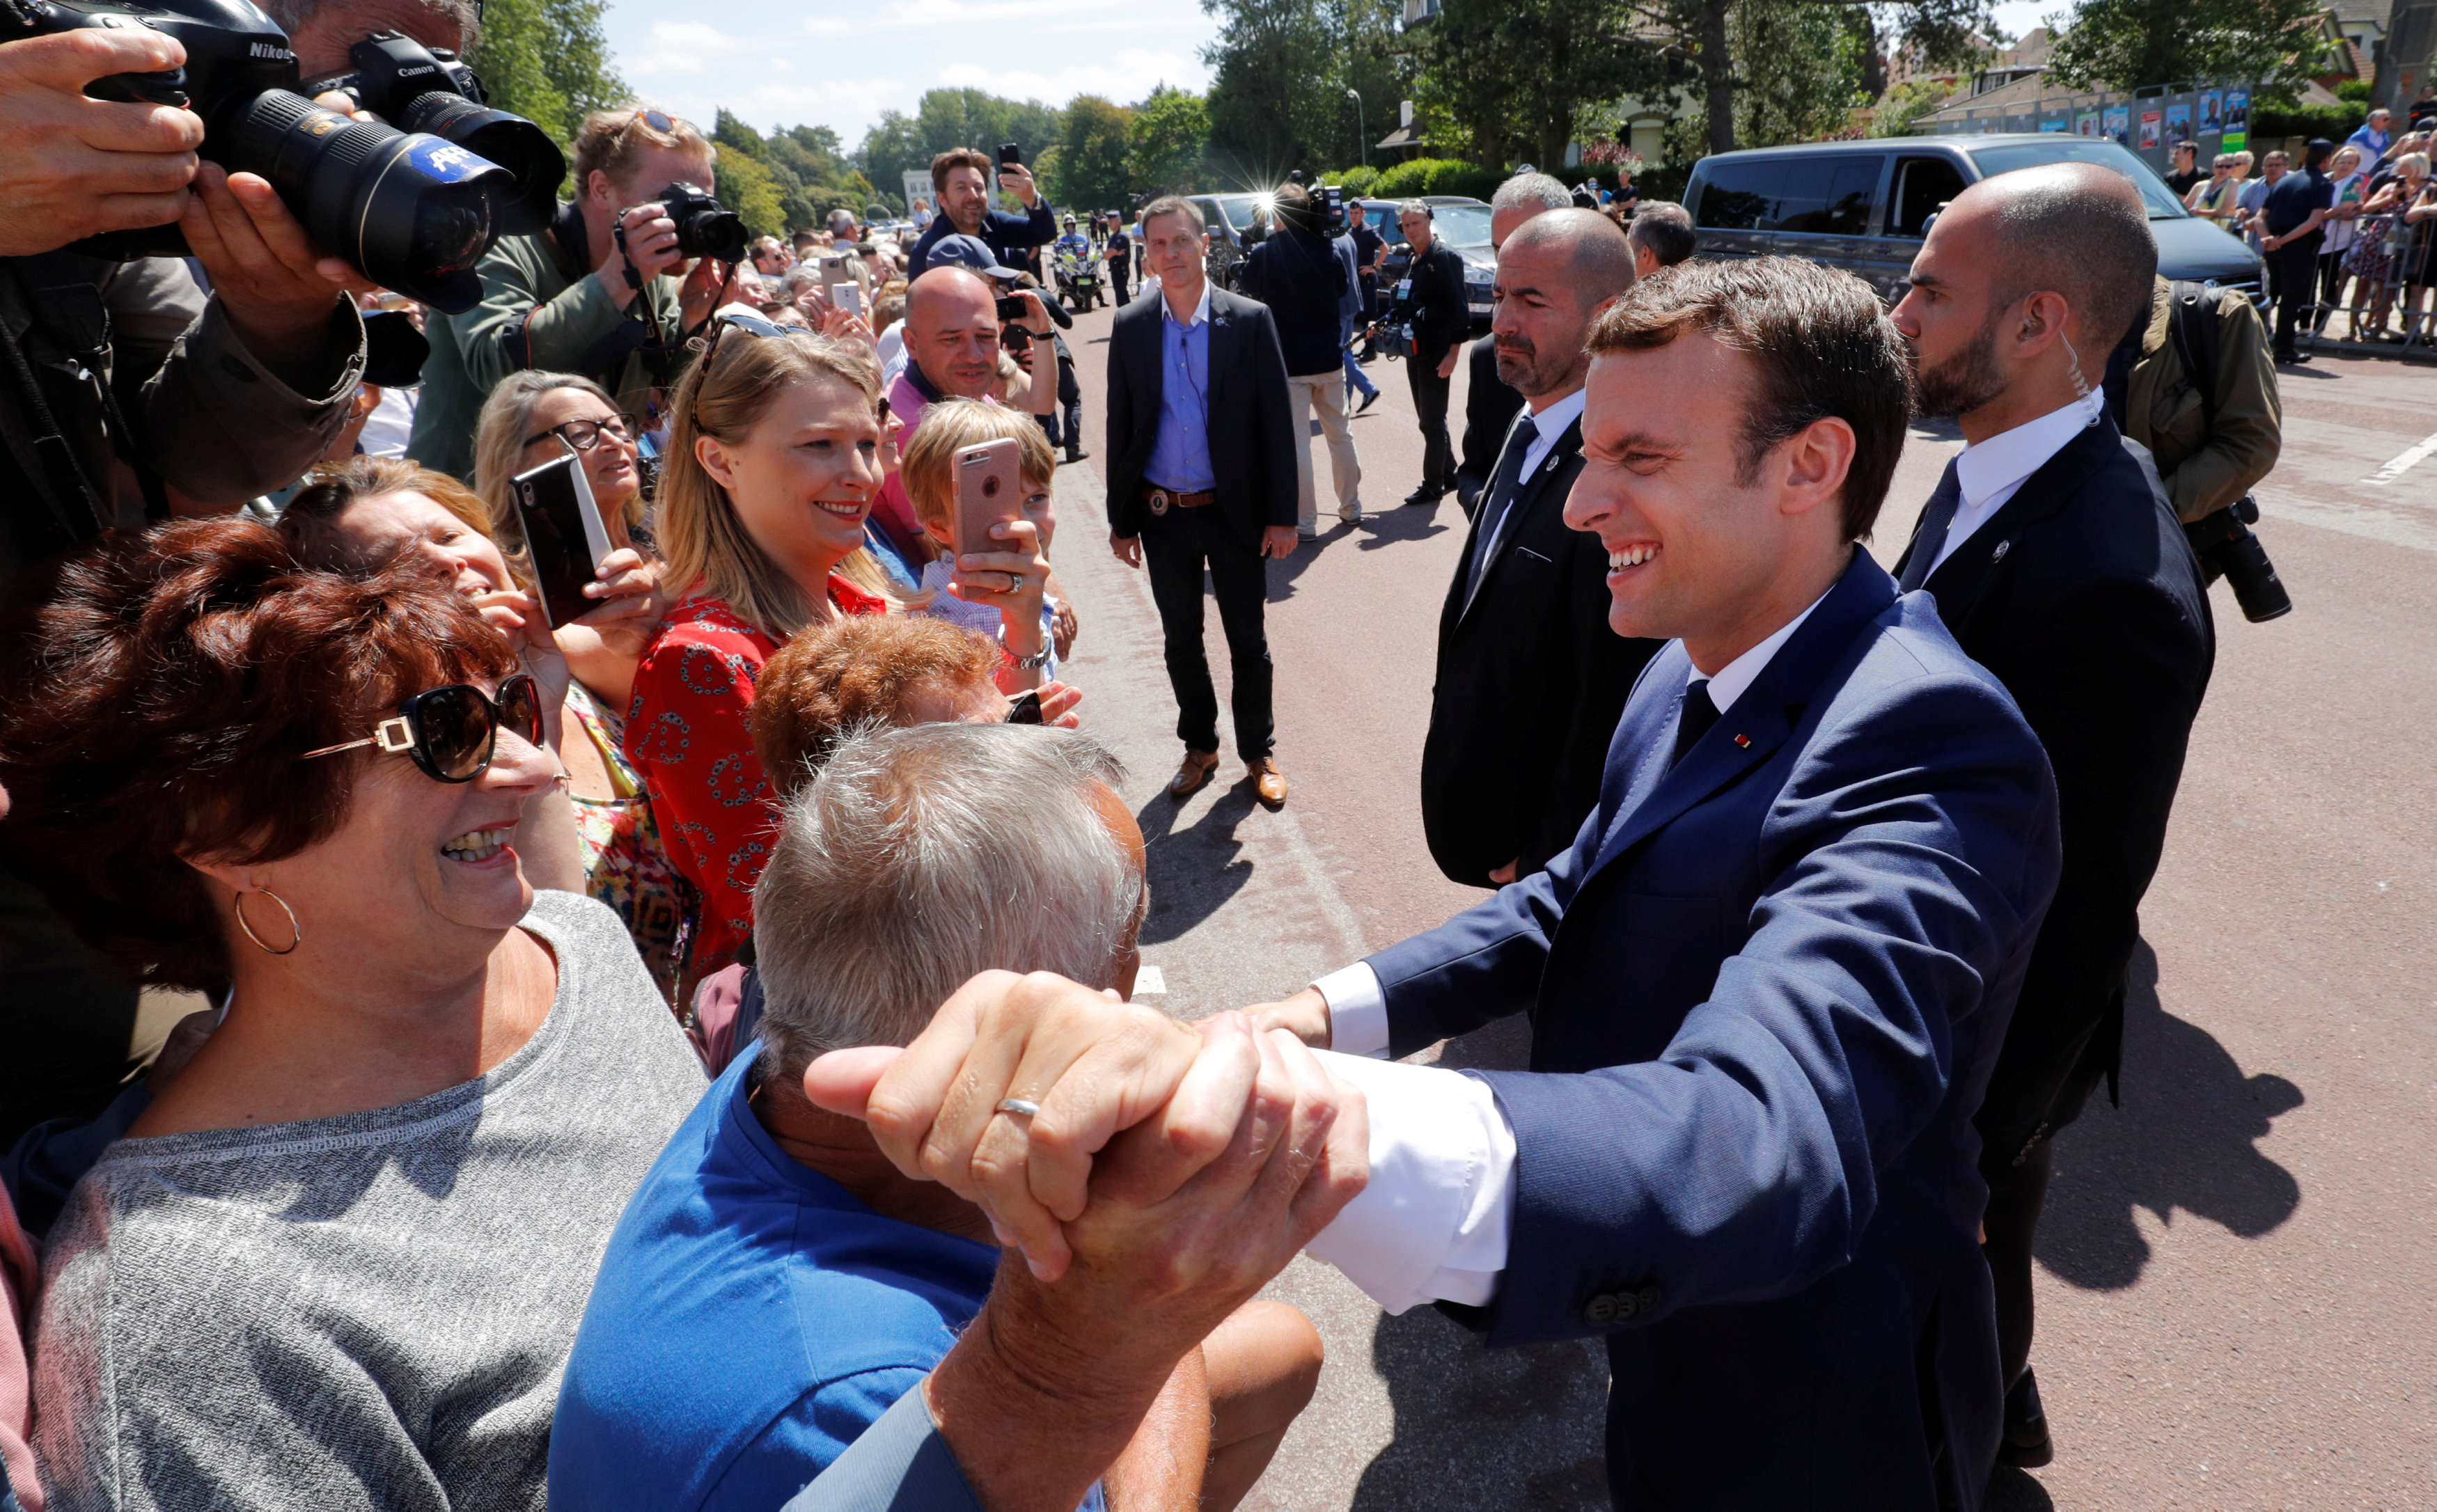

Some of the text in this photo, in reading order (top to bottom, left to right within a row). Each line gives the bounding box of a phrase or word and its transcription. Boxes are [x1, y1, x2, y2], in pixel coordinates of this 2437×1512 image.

[250, 42, 290, 59] Nikon
[398, 65, 434, 77] Canon
[429, 145, 471, 173] AFP
